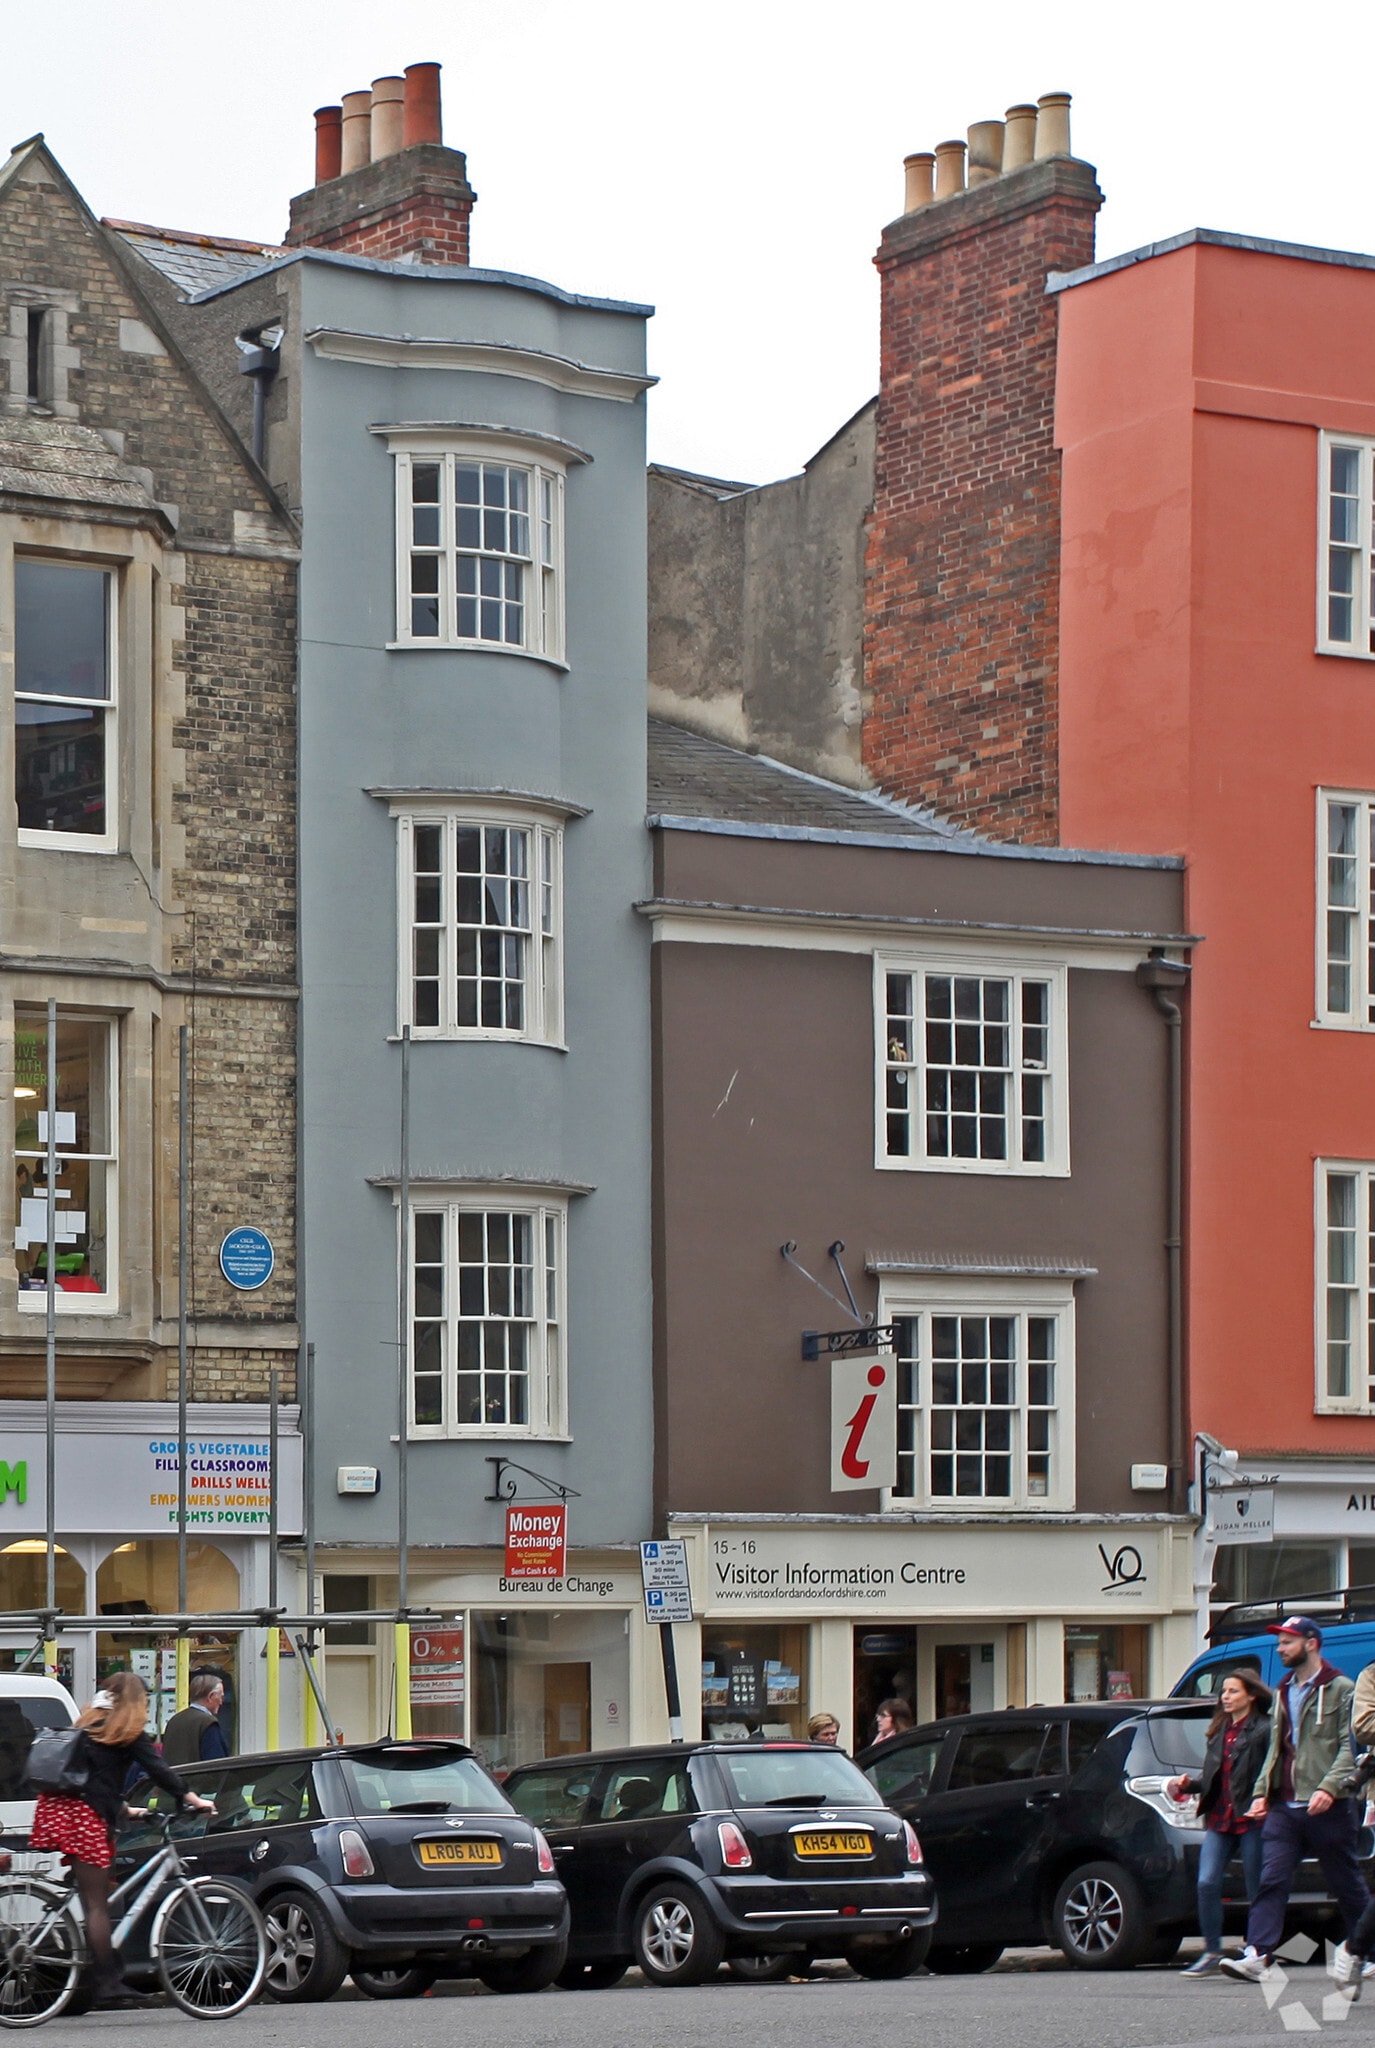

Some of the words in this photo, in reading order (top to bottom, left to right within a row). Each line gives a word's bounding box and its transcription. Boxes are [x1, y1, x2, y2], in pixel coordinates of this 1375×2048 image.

[199, 1443, 271, 1456] VEGETABLE
[191, 1476, 232, 1489] DRILLS
[150, 1494, 221, 1506] EMPWERS
[510, 1513, 561, 1535] Money
[1216, 1523, 1240, 1531] AIDAN
[509, 1534, 563, 1551] Exchange
[713, 1541, 728, 1554] 15
[741, 1541, 756, 1554] 16
[526, 1567, 541, 1575] Cash
[548, 1566, 557, 1574] Go
[716, 1563, 779, 1584] Visitor
[785, 1563, 894, 1584] Information
[900, 1563, 966, 1584] Centre
[499, 1577, 543, 1592] Bureau
[547, 1577, 563, 1592] de
[566, 1577, 614, 1596] Change
[651, 1592, 660, 1605] P
[716, 1588, 886, 1599] www.visitoxfordandoxfordshire.com
[801, 1836, 837, 1850] KH54
[840, 1836, 866, 1849] VGO
[426, 1845, 464, 1859] LR06
[468, 1845, 494, 1859] AUJ
